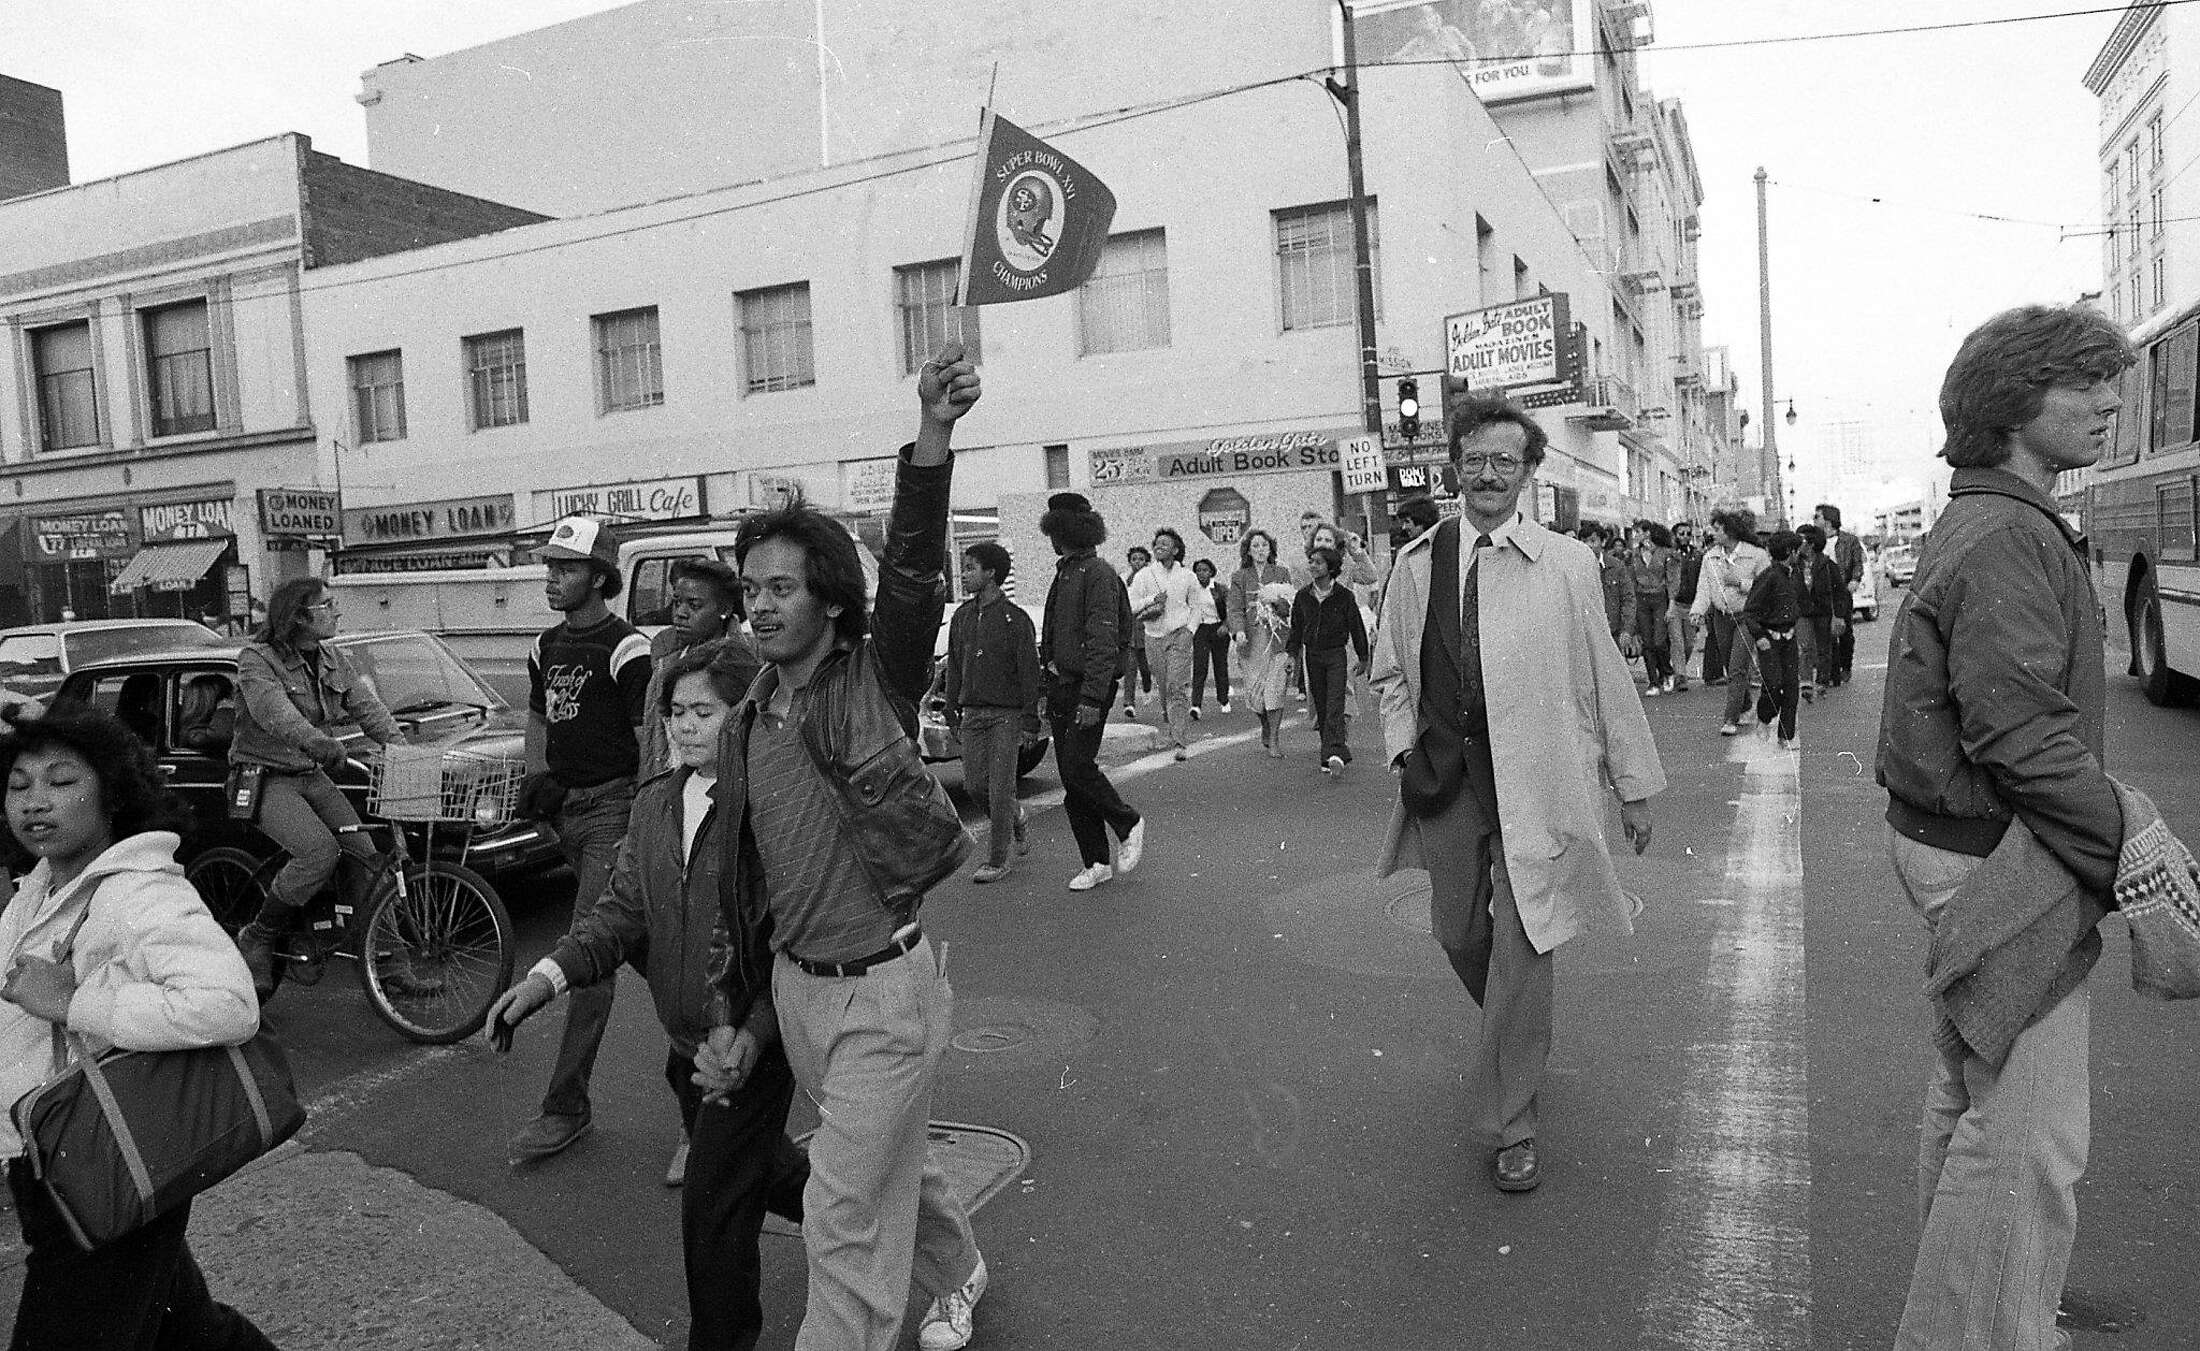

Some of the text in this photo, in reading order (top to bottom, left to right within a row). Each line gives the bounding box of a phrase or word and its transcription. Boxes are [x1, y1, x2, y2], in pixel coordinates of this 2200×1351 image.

[1475, 65, 1529, 84] FOR YOU
[996, 150, 1077, 200] SUPER BOWL XVI
[993, 260, 1048, 291] CHAMPIONS
[1504, 302, 1551, 320] ADULT
[1501, 313, 1553, 337] BOOK
[1452, 350, 1495, 374] ADULT
[1498, 339, 1553, 365] MOVIES
[1206, 431, 1328, 458] Golden Gate
[1350, 440, 1371, 454] NO
[1168, 455, 1224, 477] Adult
[1234, 449, 1290, 471] Book
[1300, 447, 1340, 465] Sto
[1346, 455, 1378, 471] LEFT
[1347, 471, 1383, 487] TURN
[286, 494, 334, 510] MONEY
[607, 487, 646, 514] GRILL
[650, 486, 694, 519] Cafe
[40, 519, 128, 533] MONEY LOAN
[142, 504, 194, 537] MONEY
[197, 500, 233, 532] LOAN
[271, 513, 334, 530] LOANED
[375, 509, 434, 537] MONEY
[448, 504, 496, 533] LOAN
